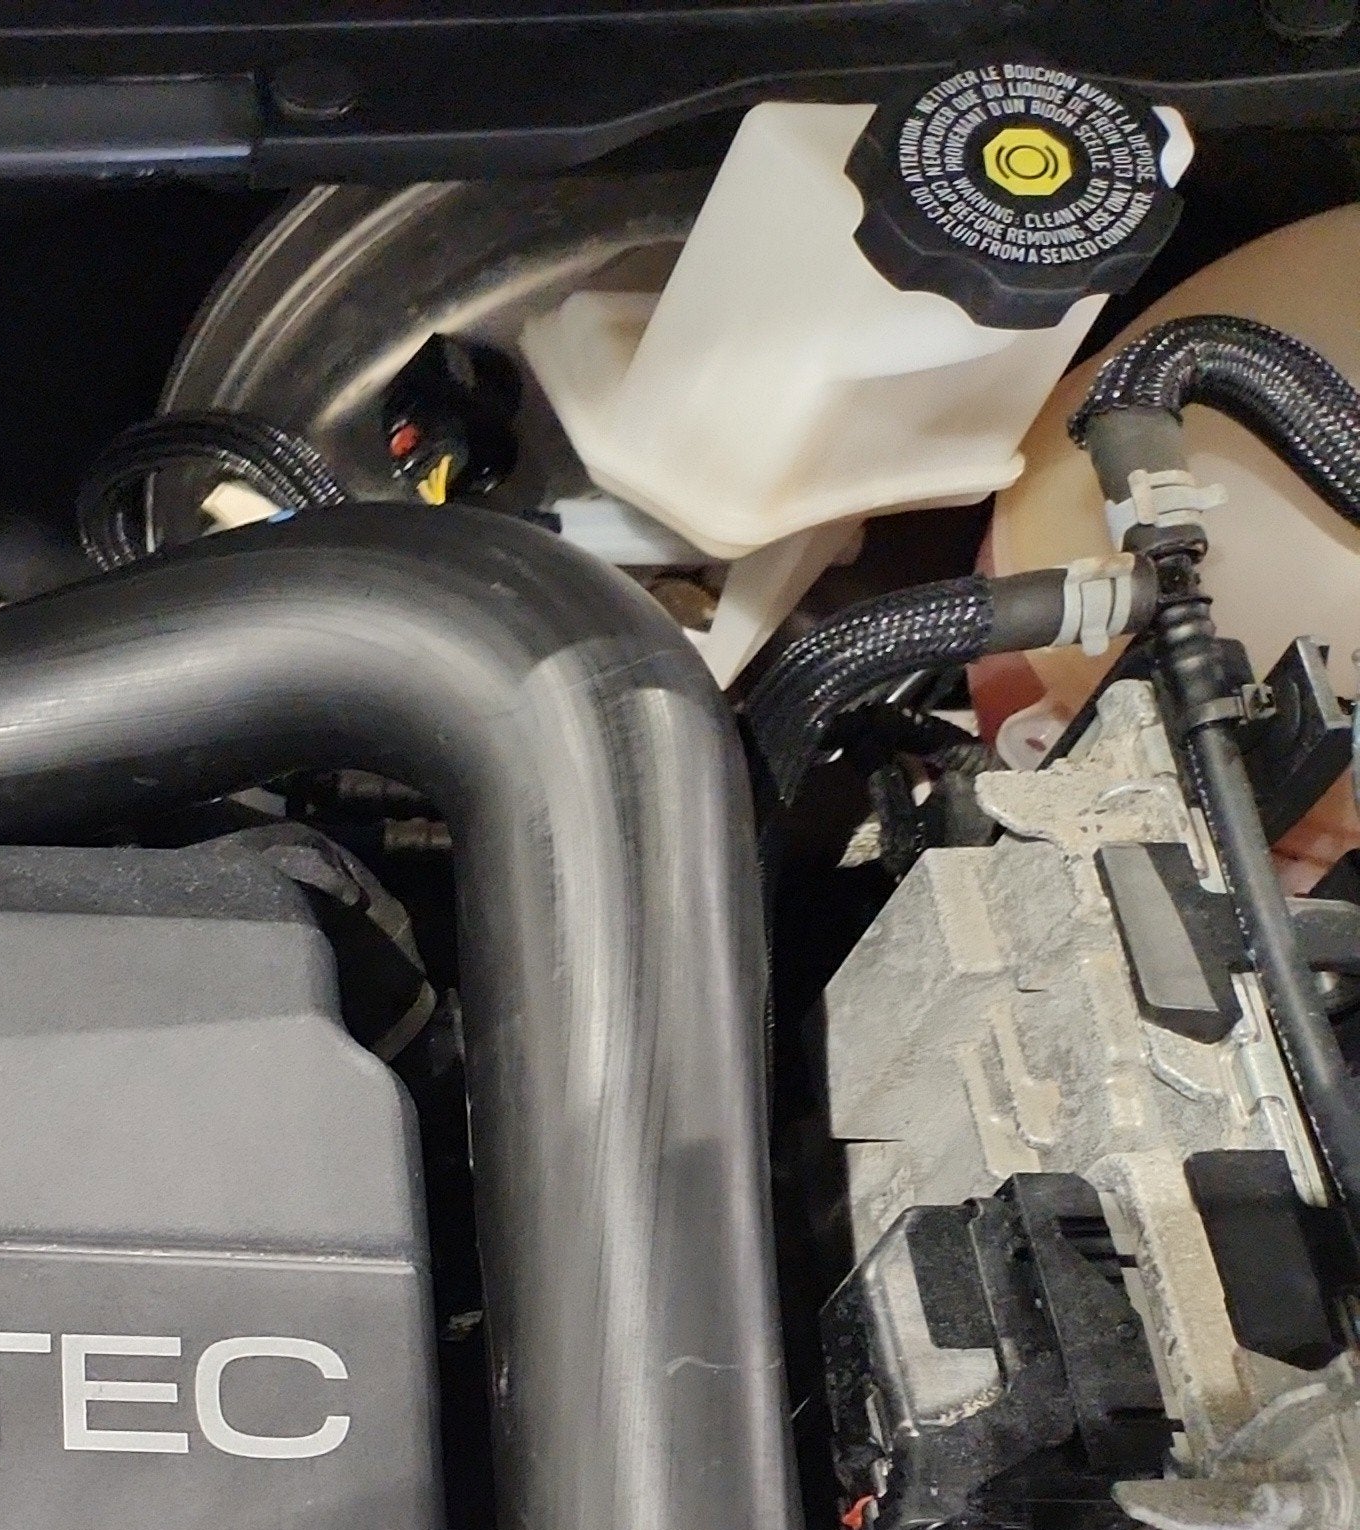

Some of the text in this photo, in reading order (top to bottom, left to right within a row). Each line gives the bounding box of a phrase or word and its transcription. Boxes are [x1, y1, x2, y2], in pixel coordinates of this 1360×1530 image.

[916, 70, 981, 114] NETTOYER
[980, 65, 1001, 81] LE
[1003, 64, 1077, 90] BOUCHON
[1076, 83, 1124, 115] AVANT
[1115, 115, 1138, 134] LA
[952, 89, 982, 111] QUE
[981, 82, 1005, 100] DU
[1007, 81, 1066, 105] LIQUIDE
[1065, 96, 1090, 116] DE
[1085, 110, 1124, 145] FREIN
[943, 106, 988, 172] PROVENANT
[1030, 99, 1080, 128] BIDON
[930, 180, 959, 203] CAP
[948, 201, 1006, 240] BEFORE
[1084, 208, 1117, 232] USE
[1104, 181, 1133, 213] ONLY
[1024, 207, 1076, 229] CLEAN
[1068, 178, 1110, 218] FILLER
[936, 214, 981, 247] FLUID
[979, 237, 1026, 262] FROM
[1027, 248, 1039, 263] A
[1040, 240, 1100, 264] SEALED
